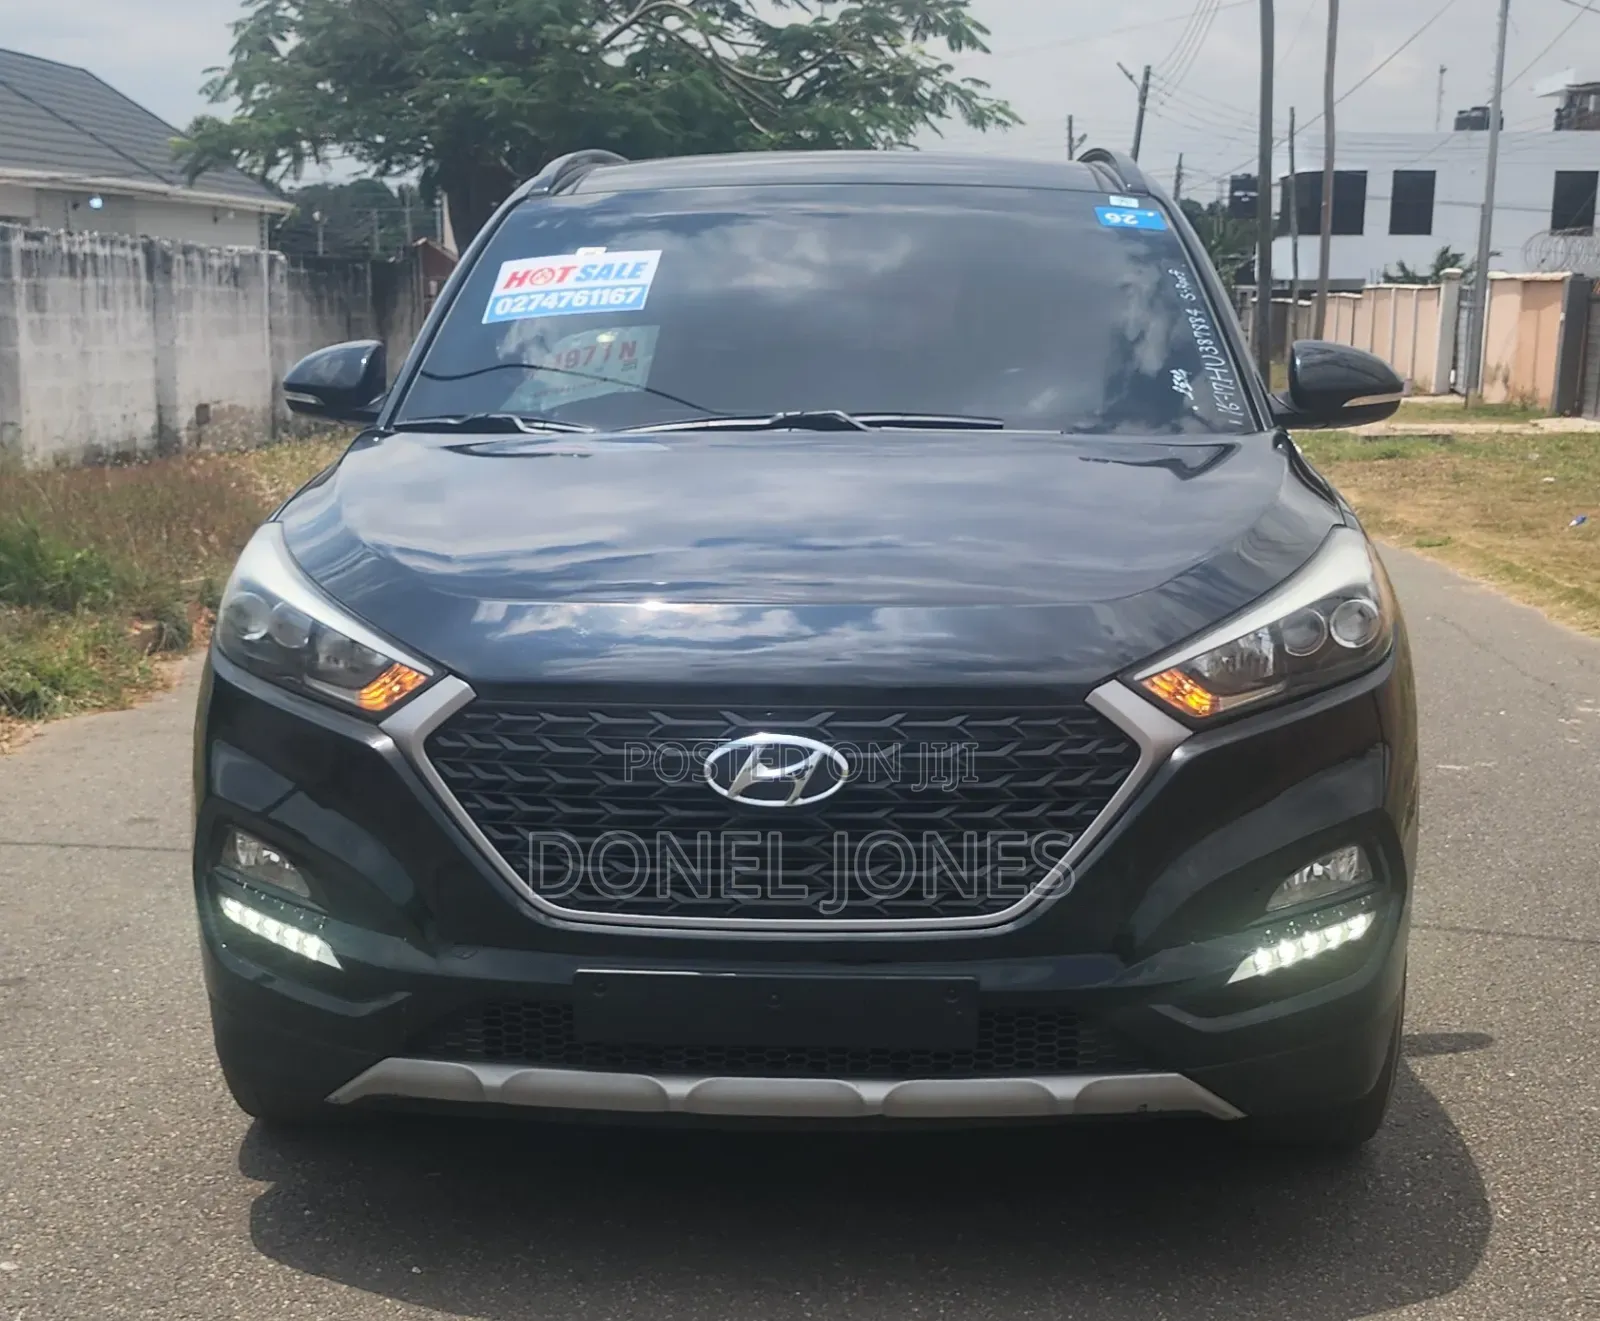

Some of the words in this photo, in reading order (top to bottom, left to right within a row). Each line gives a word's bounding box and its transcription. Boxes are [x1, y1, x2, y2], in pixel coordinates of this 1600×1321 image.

[503, 265, 578, 289] HOT
[575, 262, 648, 282] SALE
[494, 287, 643, 315] 0274761167
